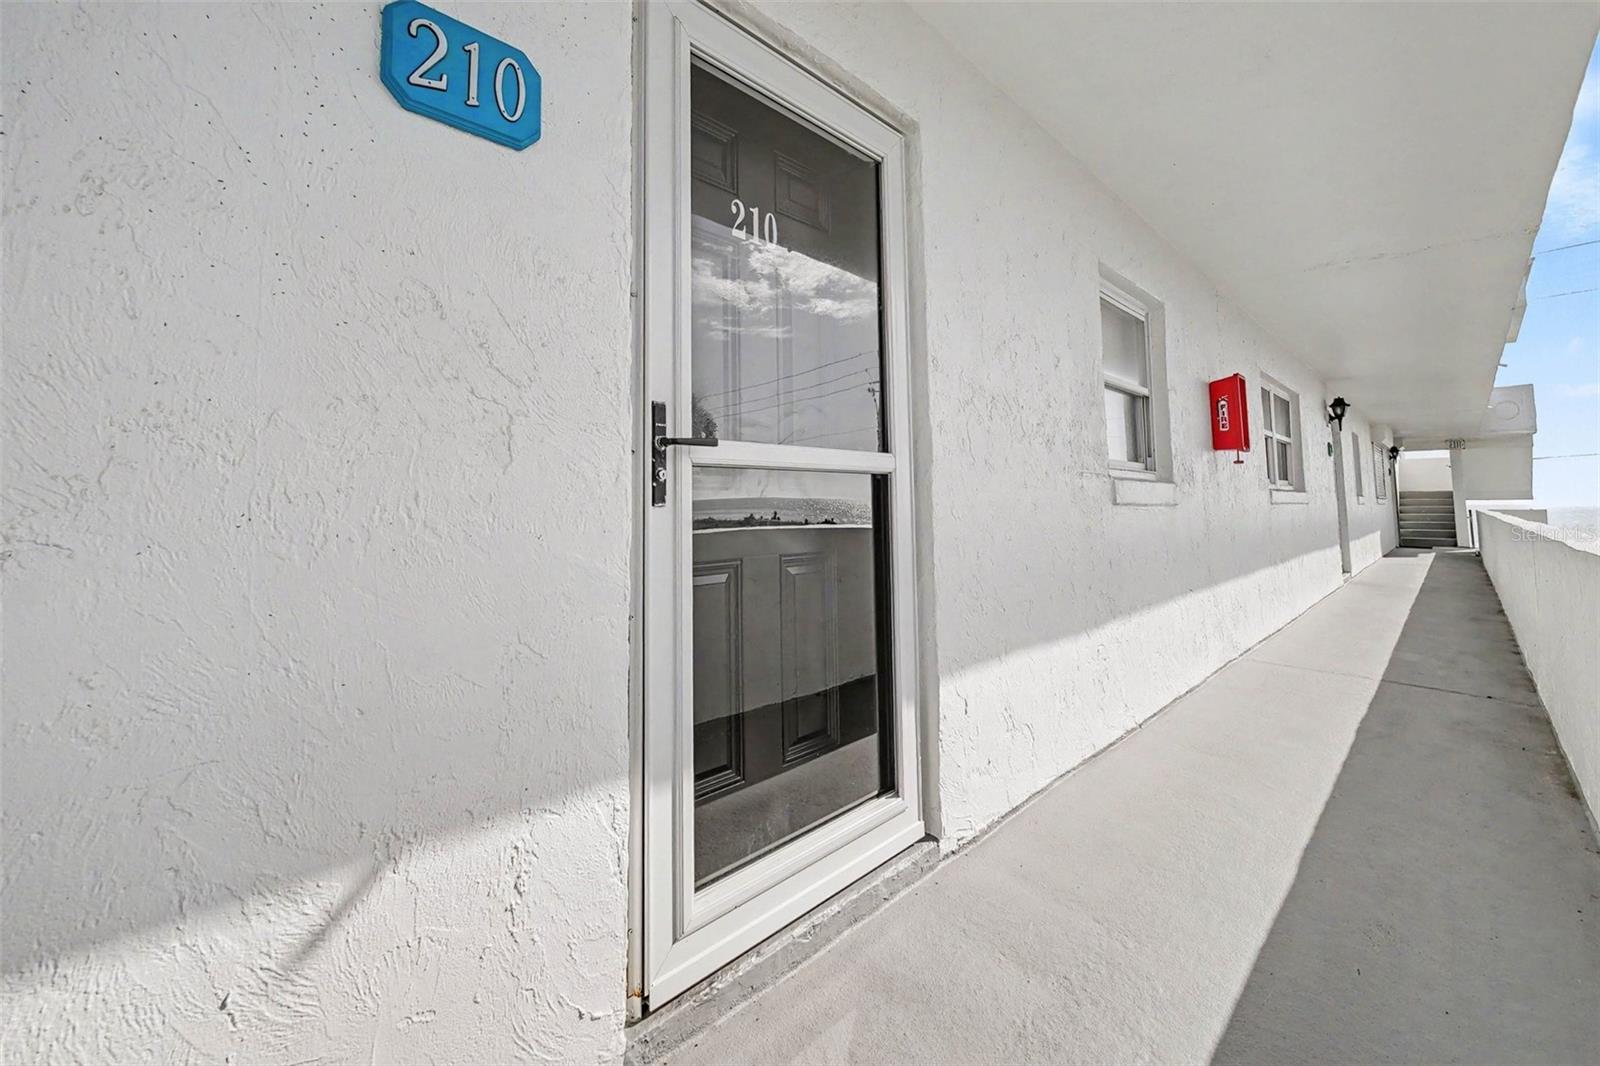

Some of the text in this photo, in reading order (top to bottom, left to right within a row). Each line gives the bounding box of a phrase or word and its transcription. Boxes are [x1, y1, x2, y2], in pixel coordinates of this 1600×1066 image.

[407, 18, 526, 123] 210
[731, 199, 778, 247] 210
[1219, 403, 1228, 429] FIRE
